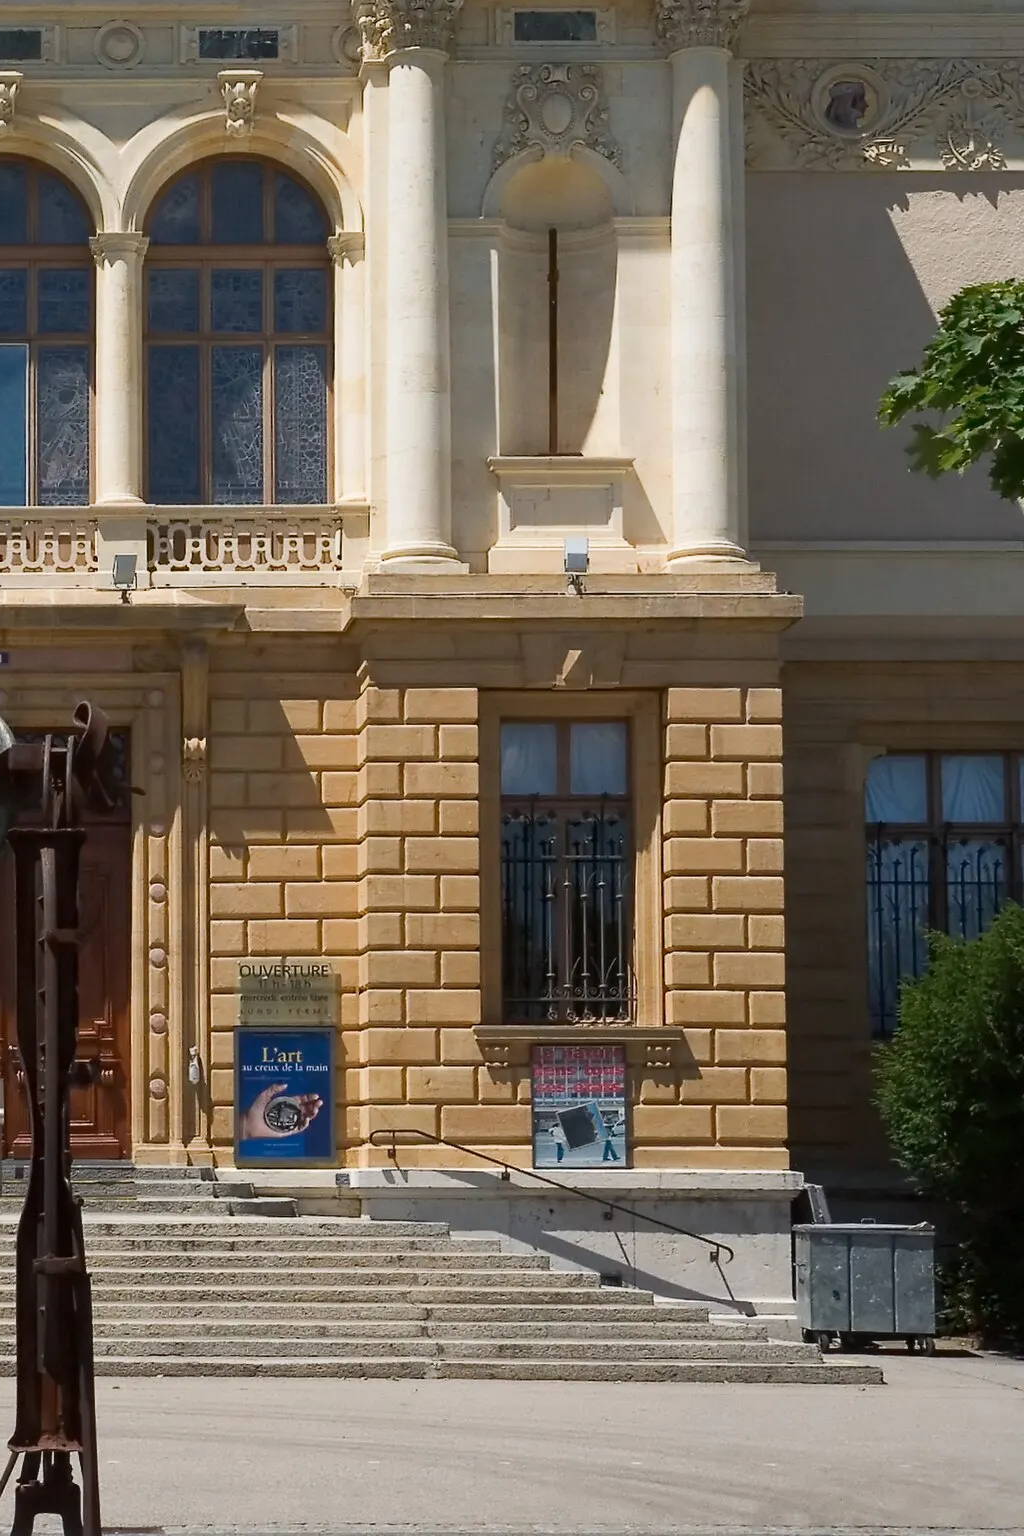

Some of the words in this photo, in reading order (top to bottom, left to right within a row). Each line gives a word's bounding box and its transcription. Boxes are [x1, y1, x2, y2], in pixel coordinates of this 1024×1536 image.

[239, 965, 329, 978] OUVERTURE
[261, 1046, 304, 1063] L'art
[241, 1064, 252, 1072] au
[254, 1064, 280, 1072] creux
[282, 1063, 293, 1072] de
[295, 1063, 304, 1072] la
[306, 1063, 329, 1072] main
